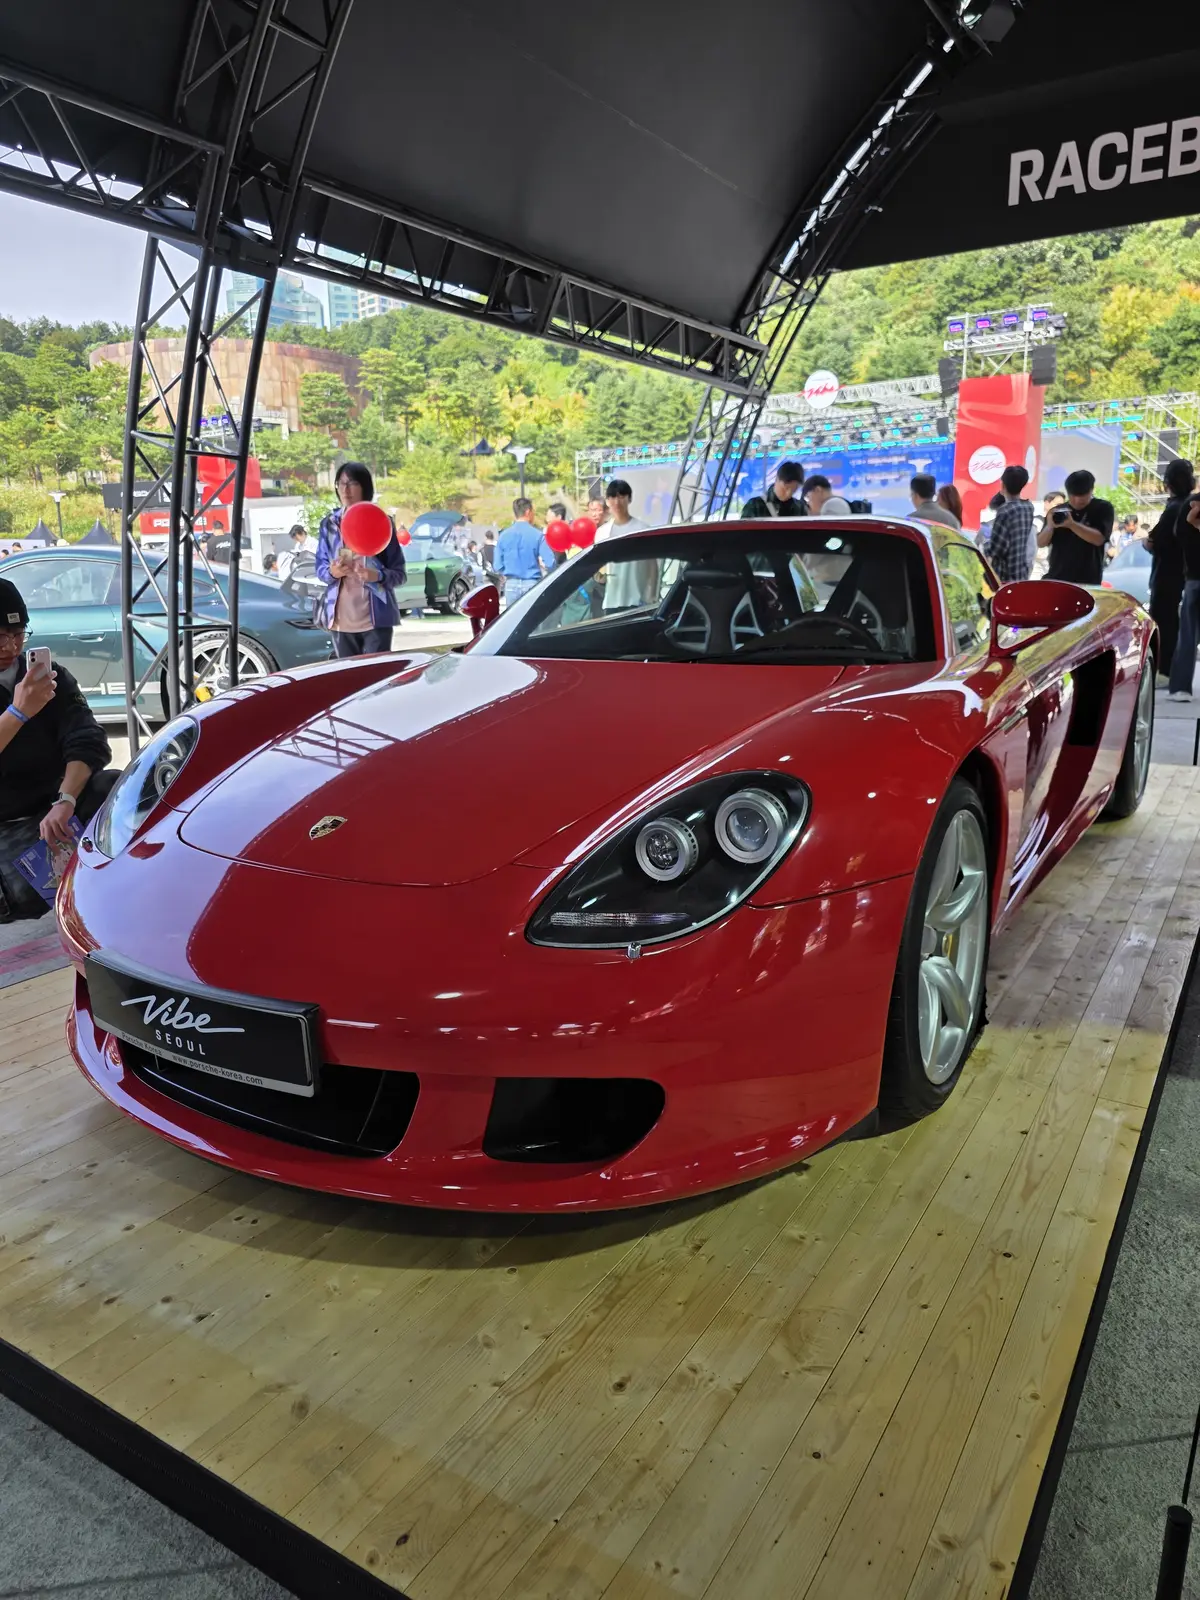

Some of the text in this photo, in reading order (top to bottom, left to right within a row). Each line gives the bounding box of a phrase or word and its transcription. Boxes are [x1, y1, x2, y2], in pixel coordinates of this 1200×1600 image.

[1008, 115, 1200, 207] RACEB
[121, 994, 246, 1033] Vibe
[155, 1029, 206, 1056] SEOUL
[172, 1054, 263, 1086] www.porsche-korea.com
